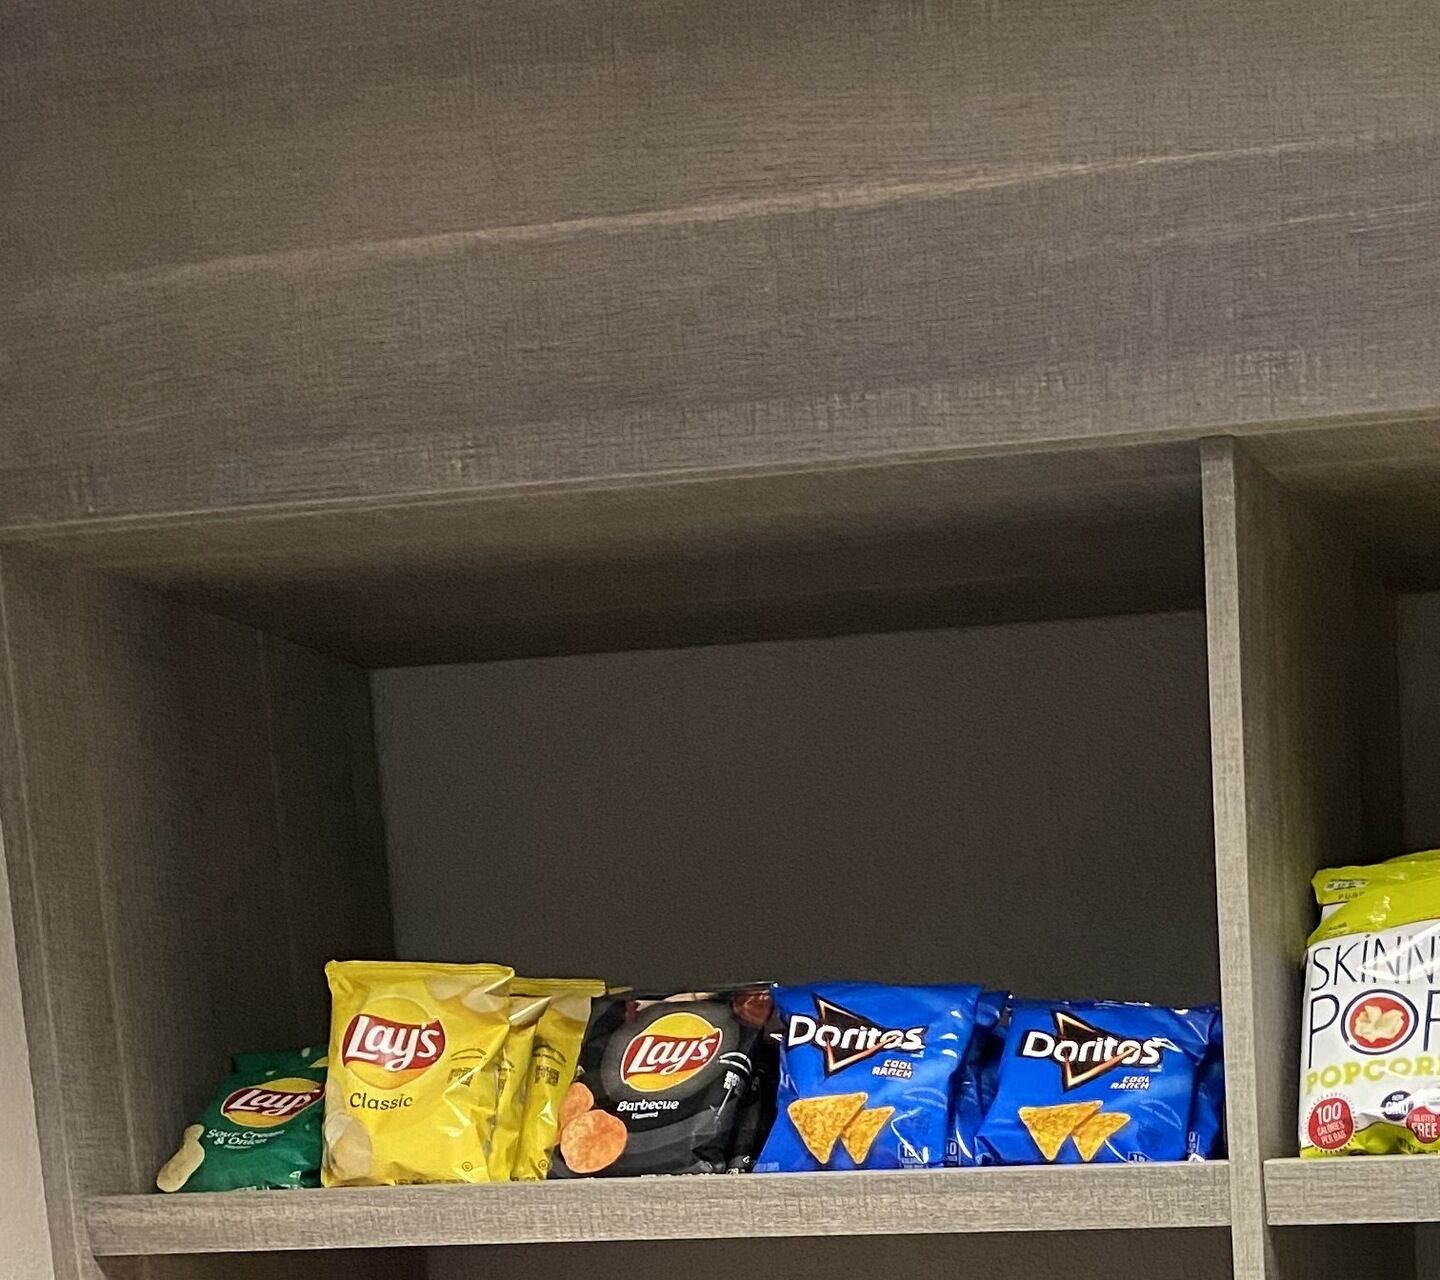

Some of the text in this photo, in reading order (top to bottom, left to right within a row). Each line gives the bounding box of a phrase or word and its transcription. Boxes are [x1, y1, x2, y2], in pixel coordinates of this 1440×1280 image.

[345, 1014, 444, 1071] Lay's
[788, 1014, 925, 1051] Doritos
[627, 1035, 716, 1075] Lay's
[1022, 1031, 1161, 1065] Doritos
[872, 1067, 913, 1078] RANCH
[883, 1059, 912, 1069] COOL
[350, 1092, 413, 1111] Classic
[617, 1099, 679, 1112] Barbecue
[1316, 1102, 1342, 1125] 100
[1411, 1122, 1438, 1138] FREE
